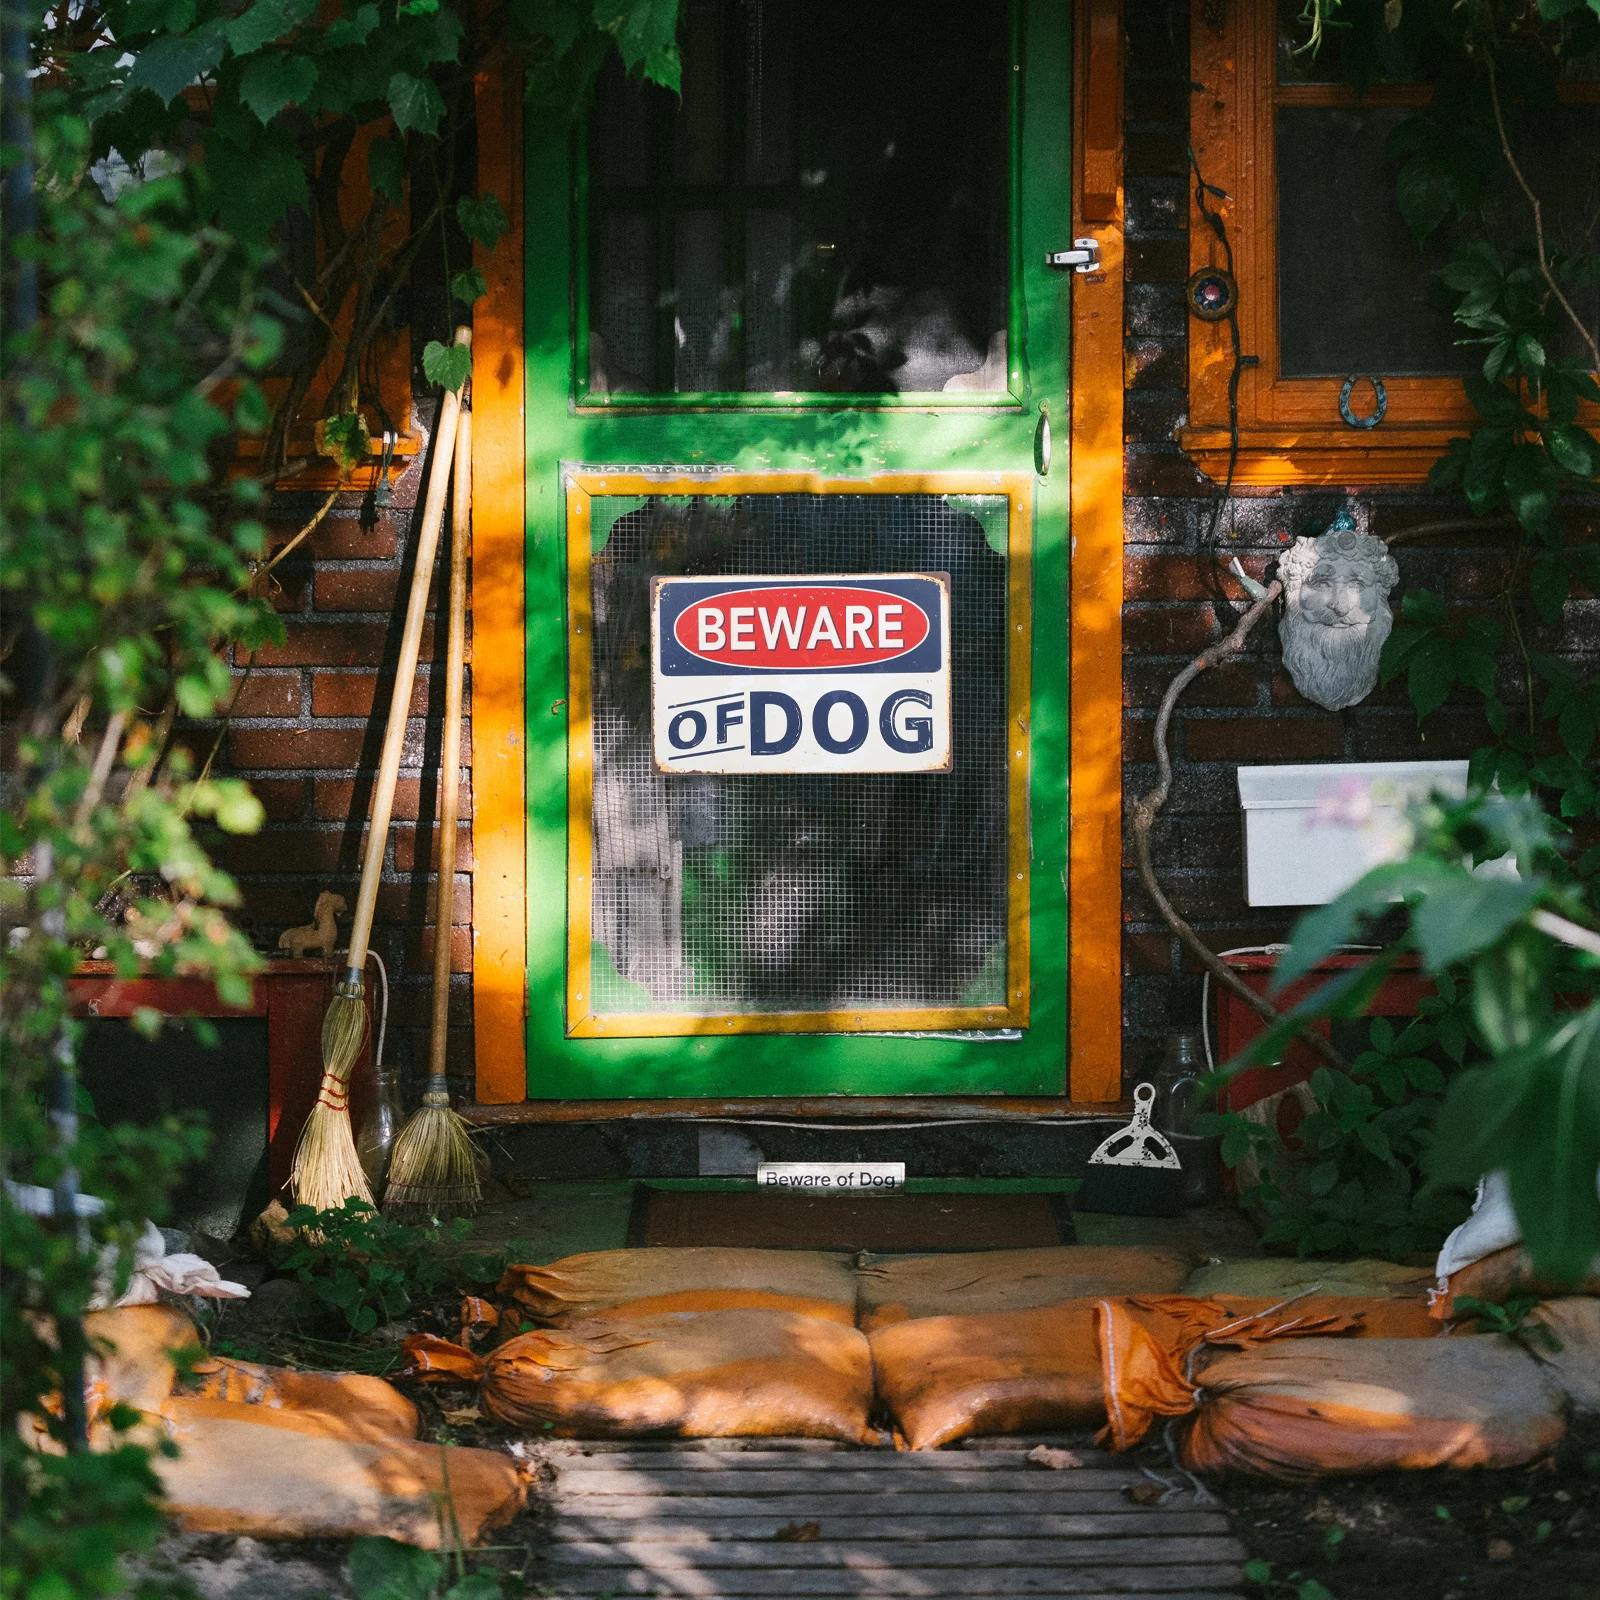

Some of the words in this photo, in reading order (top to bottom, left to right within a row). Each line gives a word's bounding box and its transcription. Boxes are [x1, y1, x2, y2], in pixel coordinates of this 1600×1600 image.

[697, 604, 905, 651] BEWARE
[667, 700, 745, 750] OF
[749, 688, 934, 756] DOG
[766, 1171, 831, 1187] Beware
[836, 1171, 854, 1187] of
[859, 1172, 895, 1189] Dog
